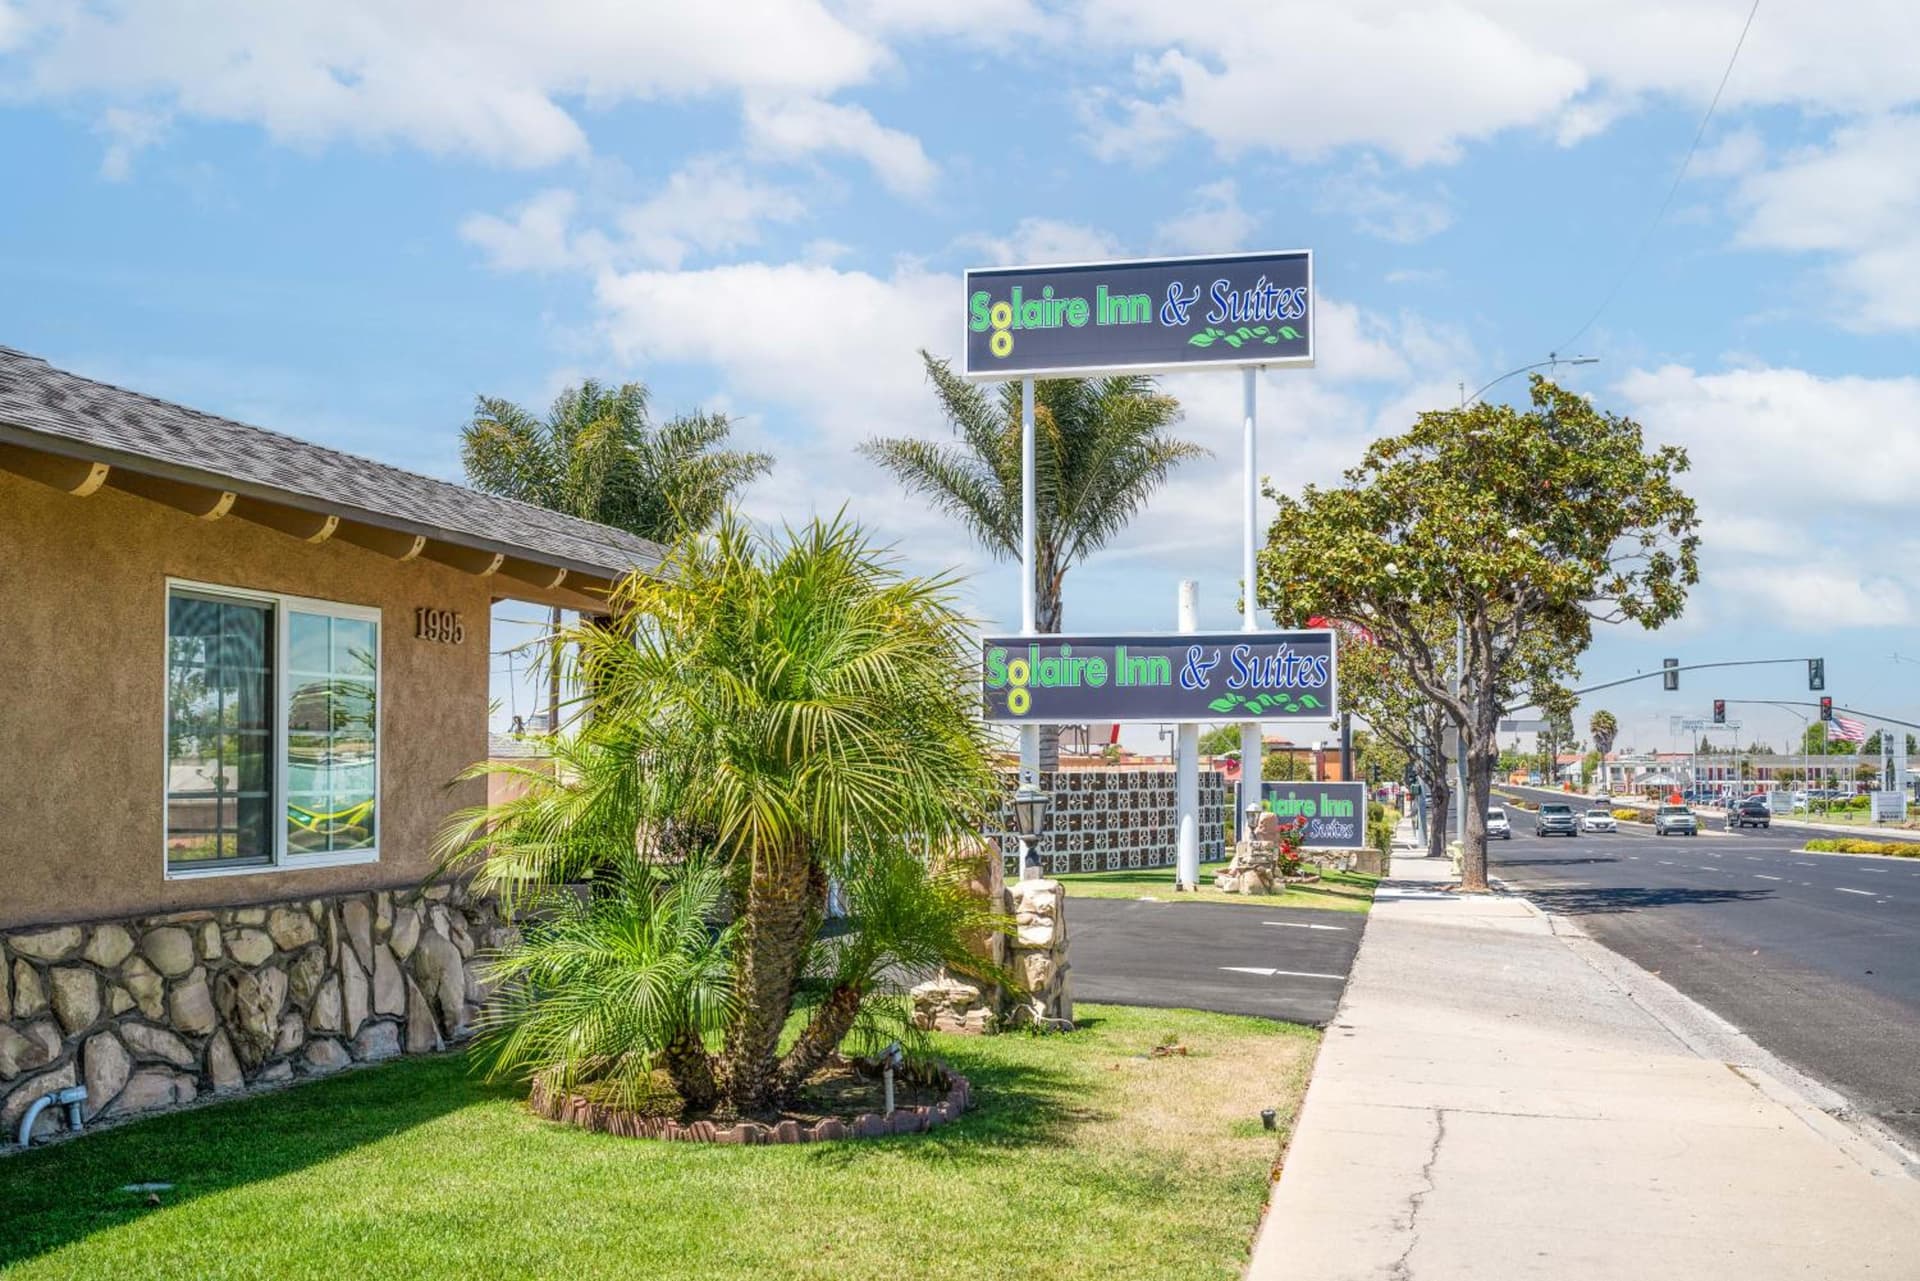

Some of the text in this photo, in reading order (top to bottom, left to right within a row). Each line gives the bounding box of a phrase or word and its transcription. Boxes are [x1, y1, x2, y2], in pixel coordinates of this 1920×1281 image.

[969, 285, 1090, 332] Solaire
[1096, 284, 1153, 326] Inn
[1160, 281, 1201, 328] &
[416, 607, 465, 644] 1995
[984, 642, 1108, 688] Solaire
[1115, 645, 1172, 686] Inn
[1179, 644, 1221, 690] &
[1320, 792, 1354, 817] Inn
